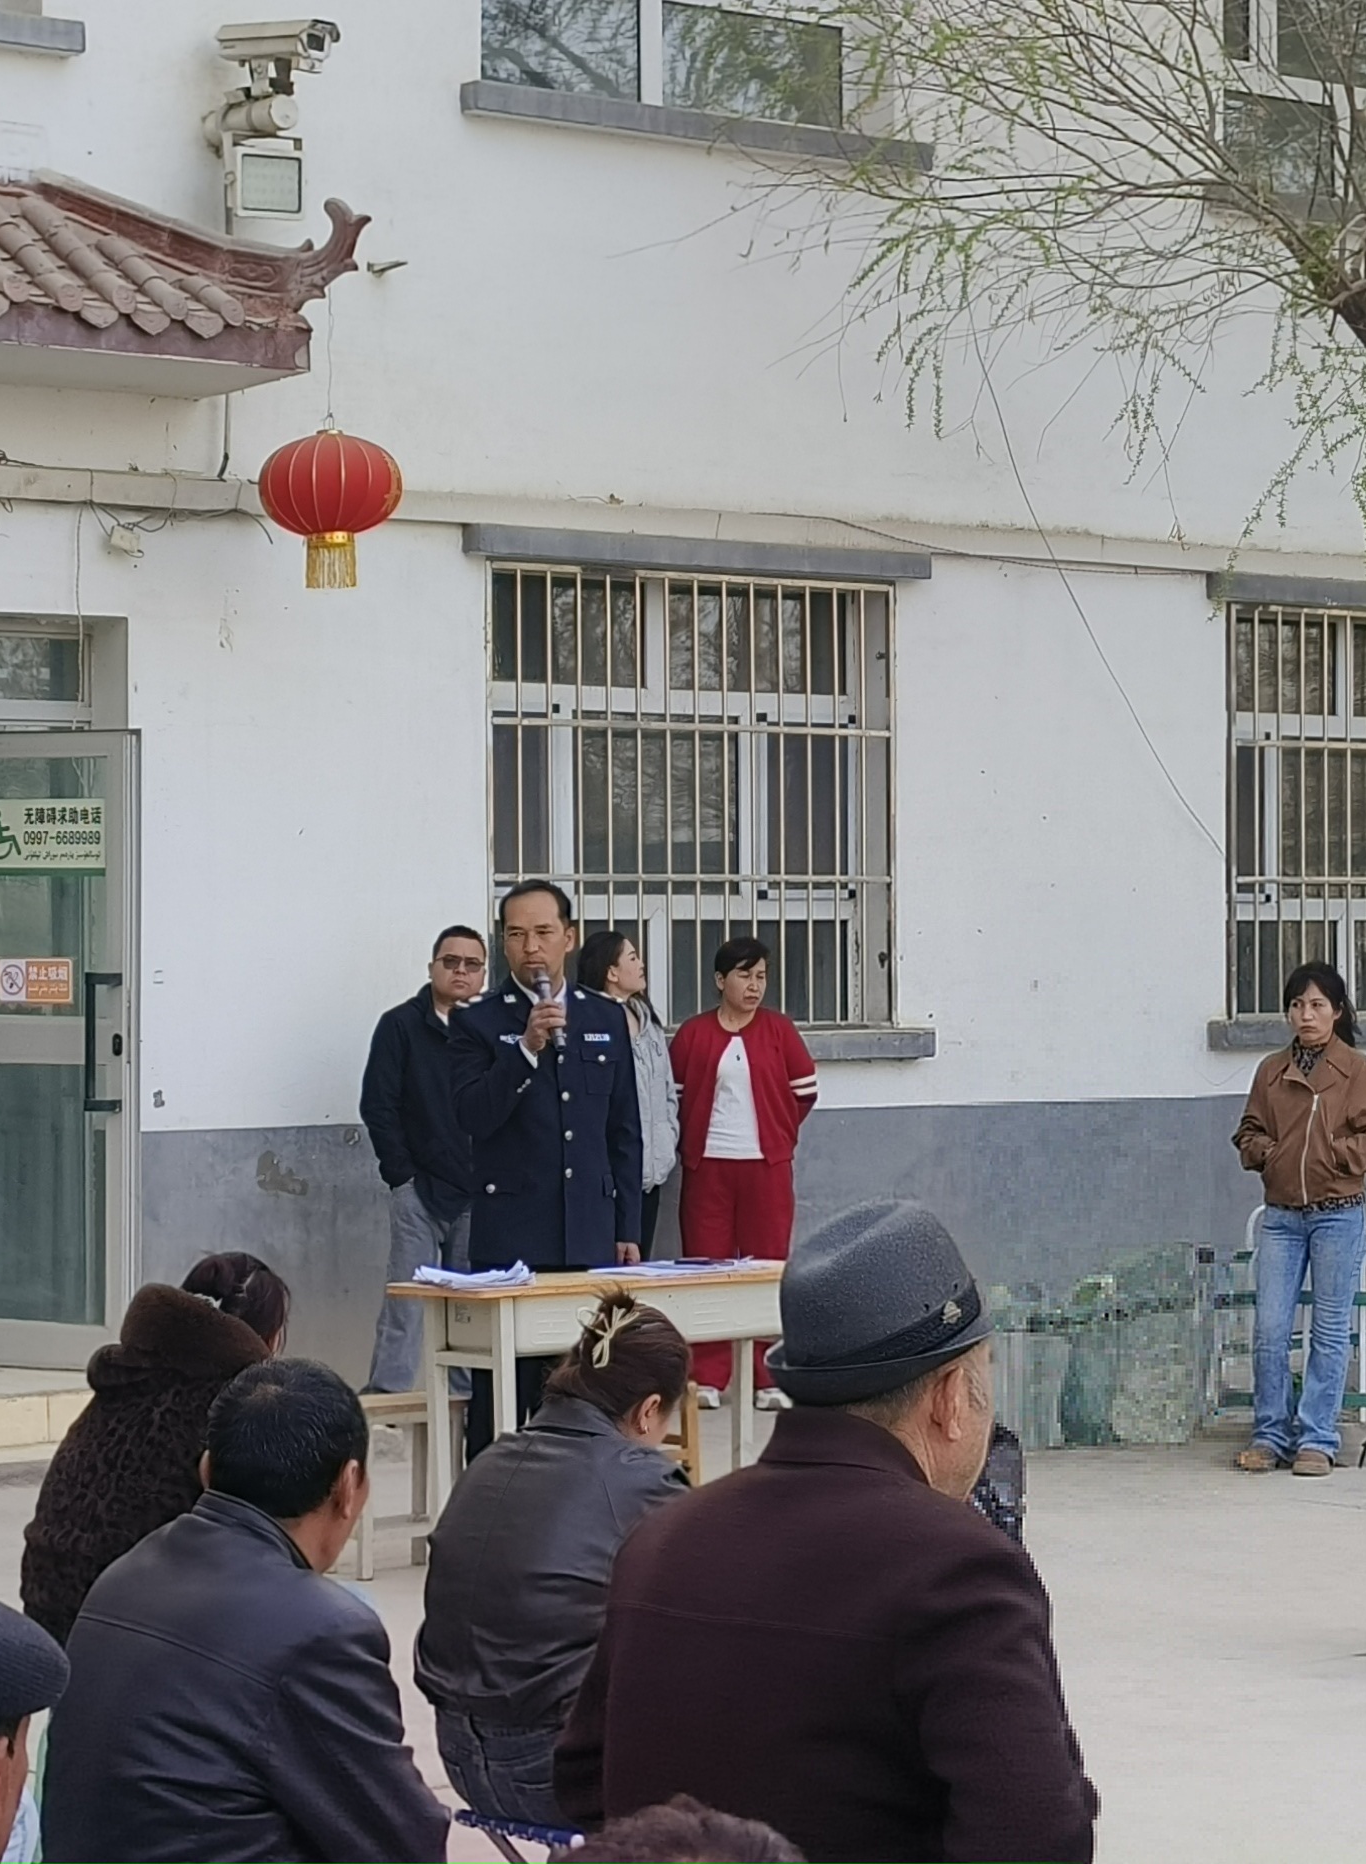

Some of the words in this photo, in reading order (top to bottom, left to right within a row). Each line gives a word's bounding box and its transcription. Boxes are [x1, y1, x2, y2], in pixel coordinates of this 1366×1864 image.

[24, 807, 101, 825] 无障碍求助电话
[23, 830, 101, 845] 0997-6689989
[28, 965, 69, 981] 禁止吸烟
